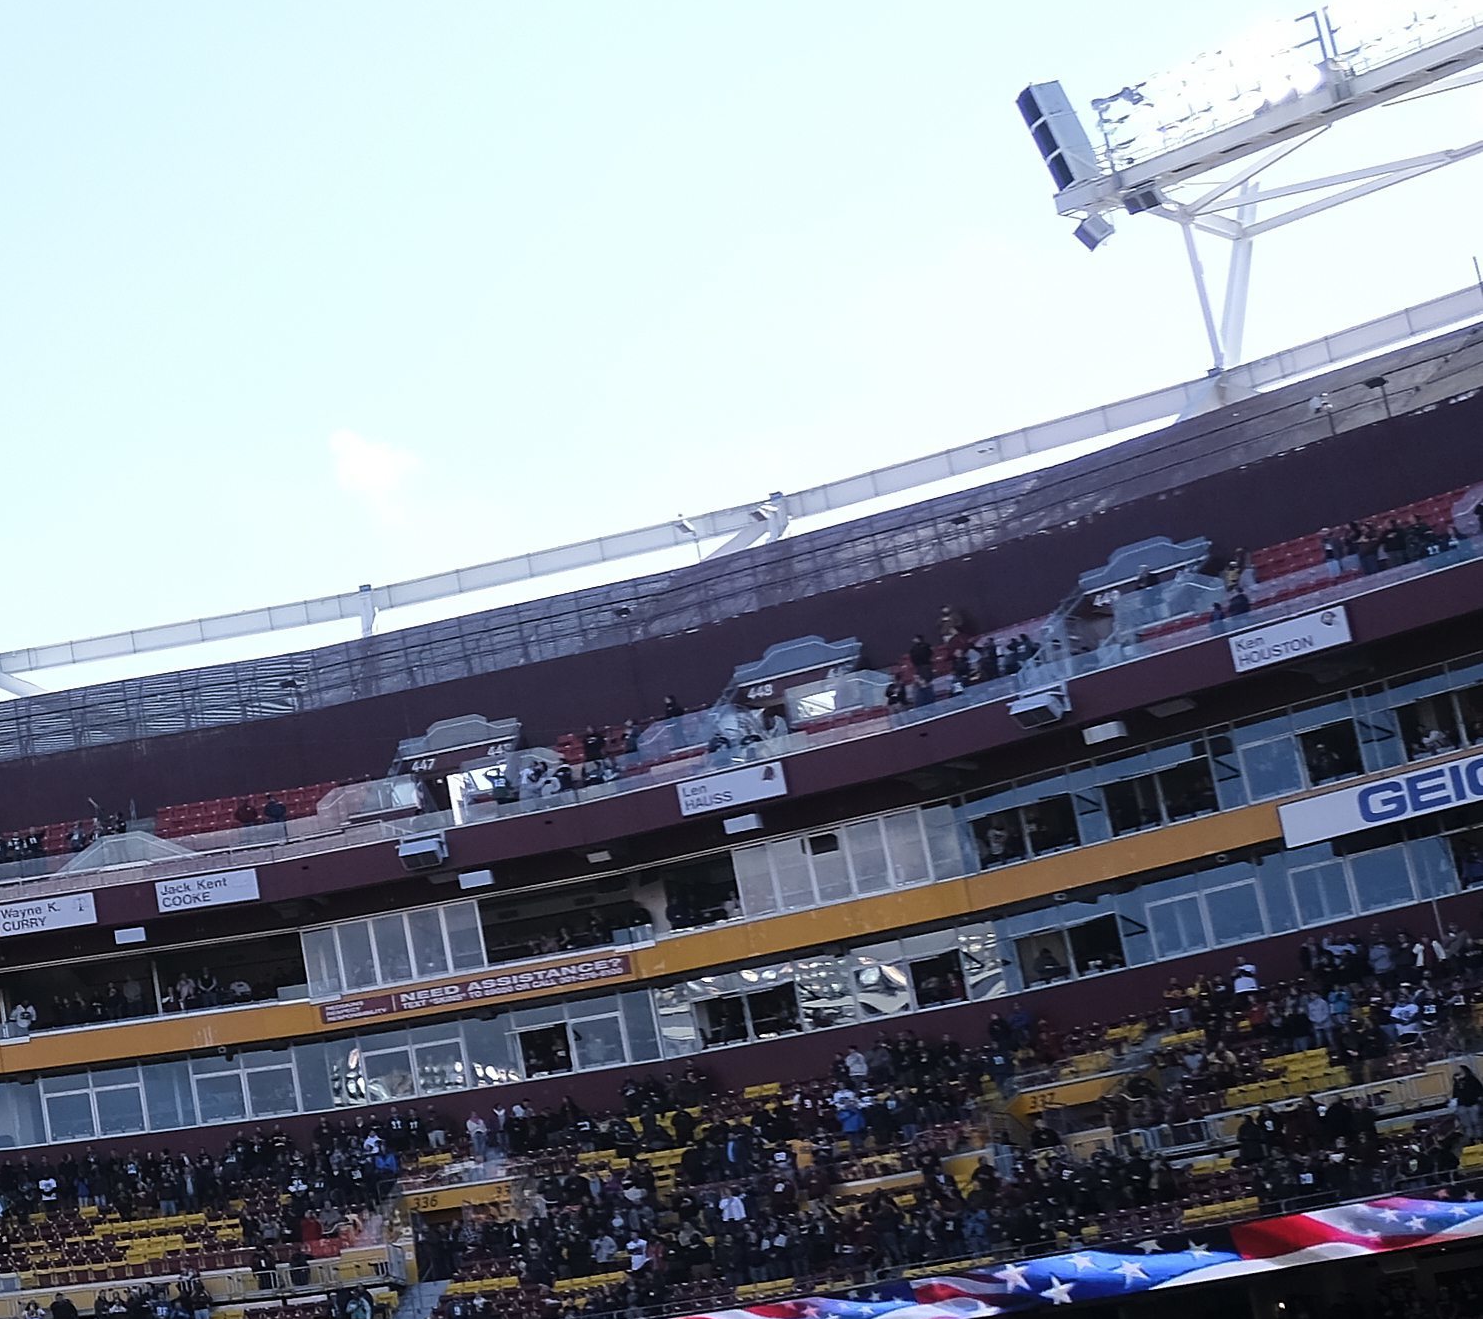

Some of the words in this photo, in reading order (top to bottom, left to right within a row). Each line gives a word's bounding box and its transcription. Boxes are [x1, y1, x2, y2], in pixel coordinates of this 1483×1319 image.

[1237, 637, 1264, 652] Ken
[1238, 635, 1313, 666] HOUSTON
[682, 784, 707, 798] Len
[684, 792, 733, 810] HAUSS
[160, 883, 191, 896] Jack
[197, 877, 227, 890] Kent
[162, 891, 211, 908] COOKE
[0, 905, 42, 920] Wayne
[48, 902, 60, 913] K.
[3, 917, 46, 932] CURRY
[400, 984, 459, 1003] NEED
[467, 957, 622, 992] ASSISTANCE?
[402, 998, 427, 1010] TEXT
[469, 990, 482, 1000] TO
[413, 1196, 439, 1210] 336
